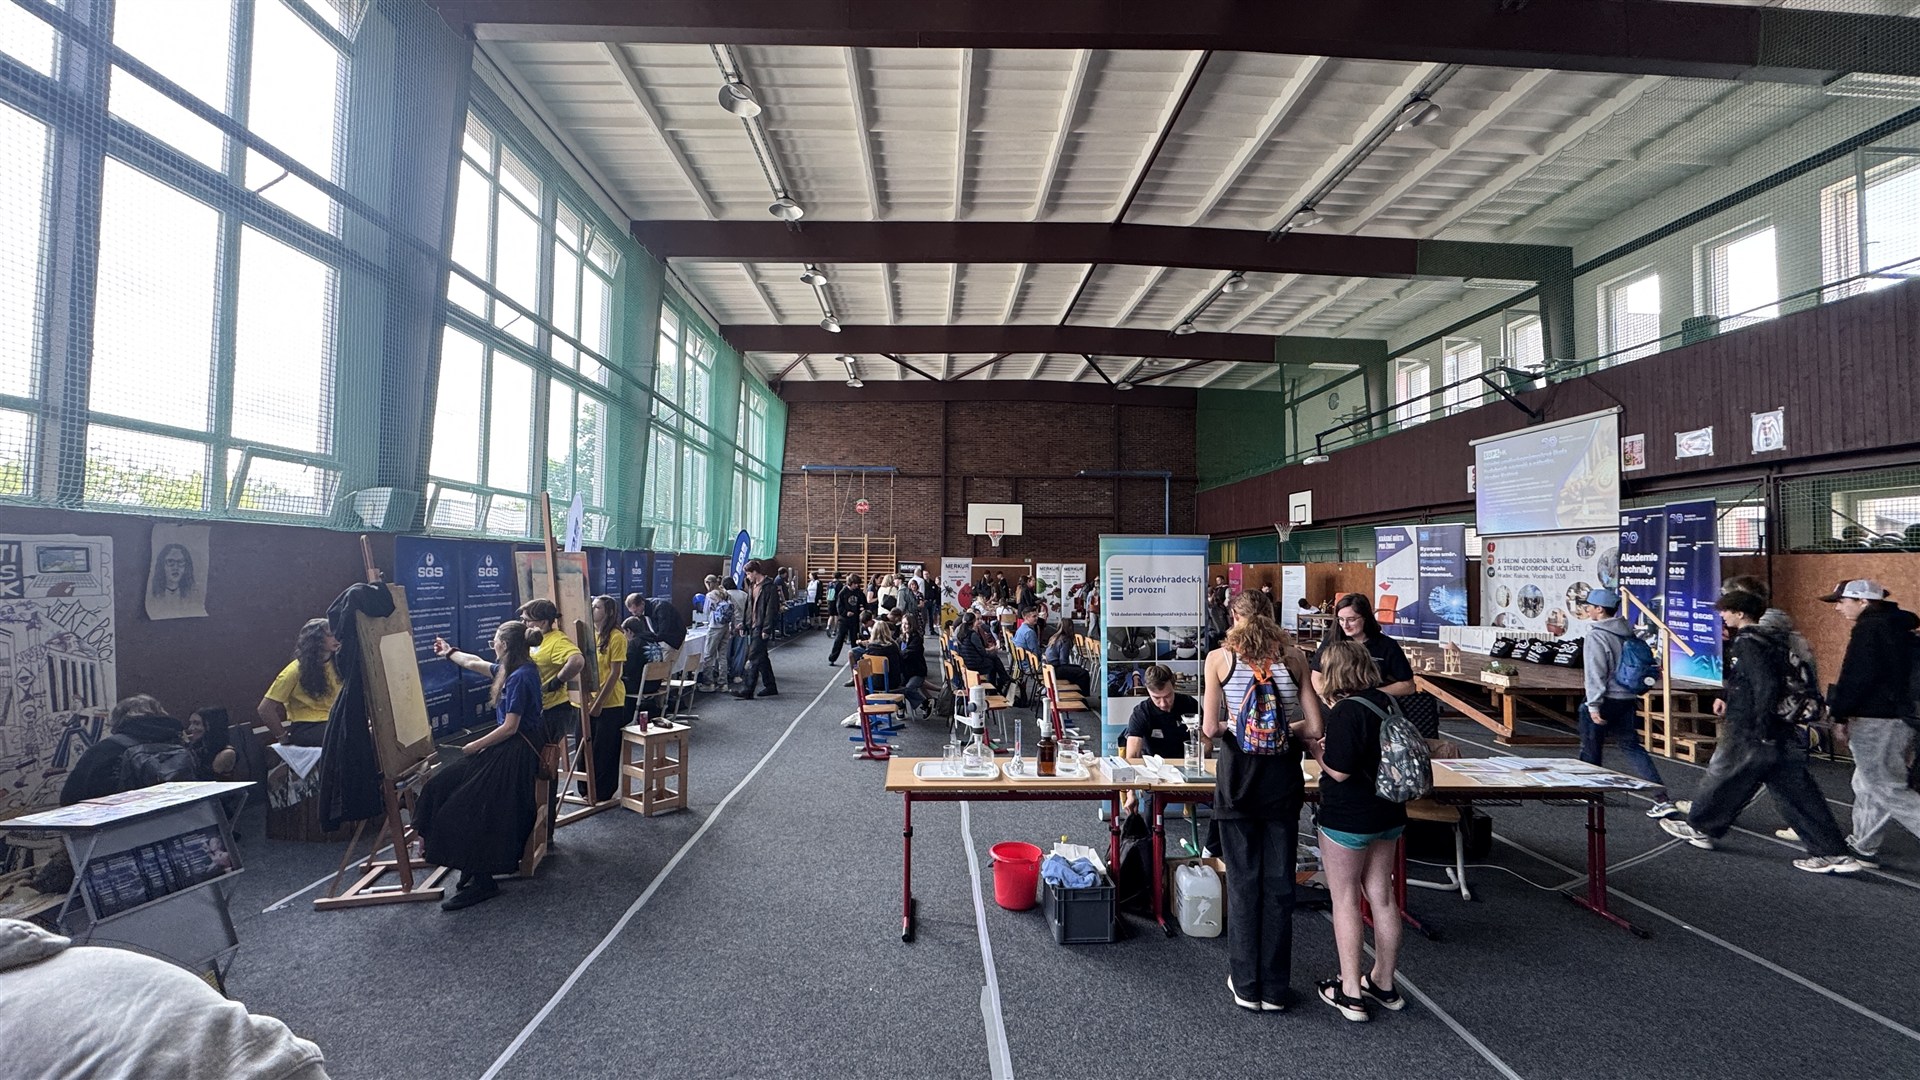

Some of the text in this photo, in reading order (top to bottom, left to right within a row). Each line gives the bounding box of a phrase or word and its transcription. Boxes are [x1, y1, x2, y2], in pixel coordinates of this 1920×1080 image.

[1620, 553, 1658, 562] Akademie
[418, 567, 443, 578] SQS
[478, 568, 499, 577] SQS
[1620, 565, 1653, 575] techniky
[1128, 575, 1202, 584] Královéhradecká
[1625, 576, 1656, 585] řemesel
[1128, 586, 1166, 595] provozní
